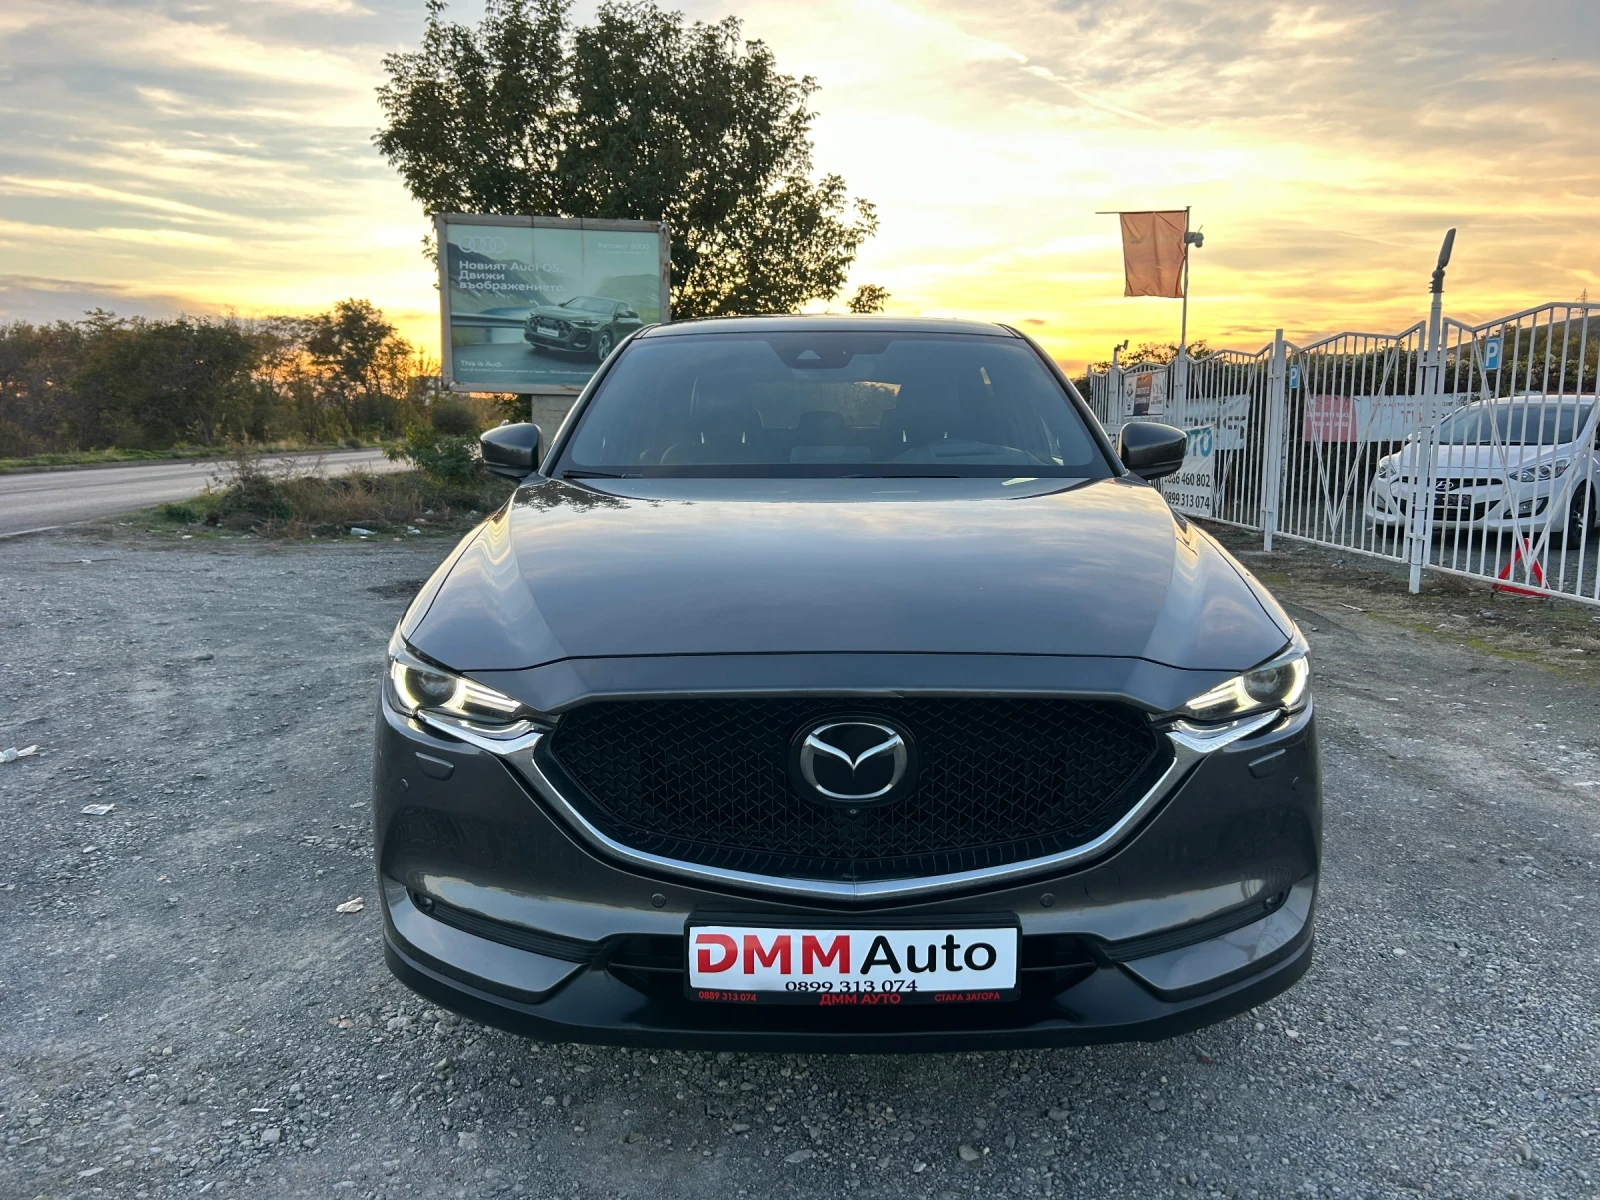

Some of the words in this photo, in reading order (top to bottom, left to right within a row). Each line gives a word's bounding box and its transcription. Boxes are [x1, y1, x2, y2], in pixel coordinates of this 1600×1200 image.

[458, 260, 507, 271] Новият
[509, 262, 539, 272] Audi
[458, 270, 506, 281] Движи
[1485, 342, 1499, 367] P
[1290, 367, 1298, 387] P
[1181, 472, 1195, 486] 460
[1196, 473, 1211, 488] 802
[1181, 493, 1194, 508] 313
[1195, 495, 1210, 510] 074
[694, 933, 850, 975] DMM
[859, 933, 998, 975] Auto
[784, 980, 834, 993] 0899
[838, 980, 876, 993] 313
[880, 979, 919, 993] 074
[722, 992, 738, 1001] 313
[740, 993, 757, 1002] 074
[819, 993, 858, 1006] ДММ
[860, 993, 902, 1005] АУТО
[934, 993, 964, 1002] СТАРА
[965, 991, 1001, 1001] ЗАГОРА
